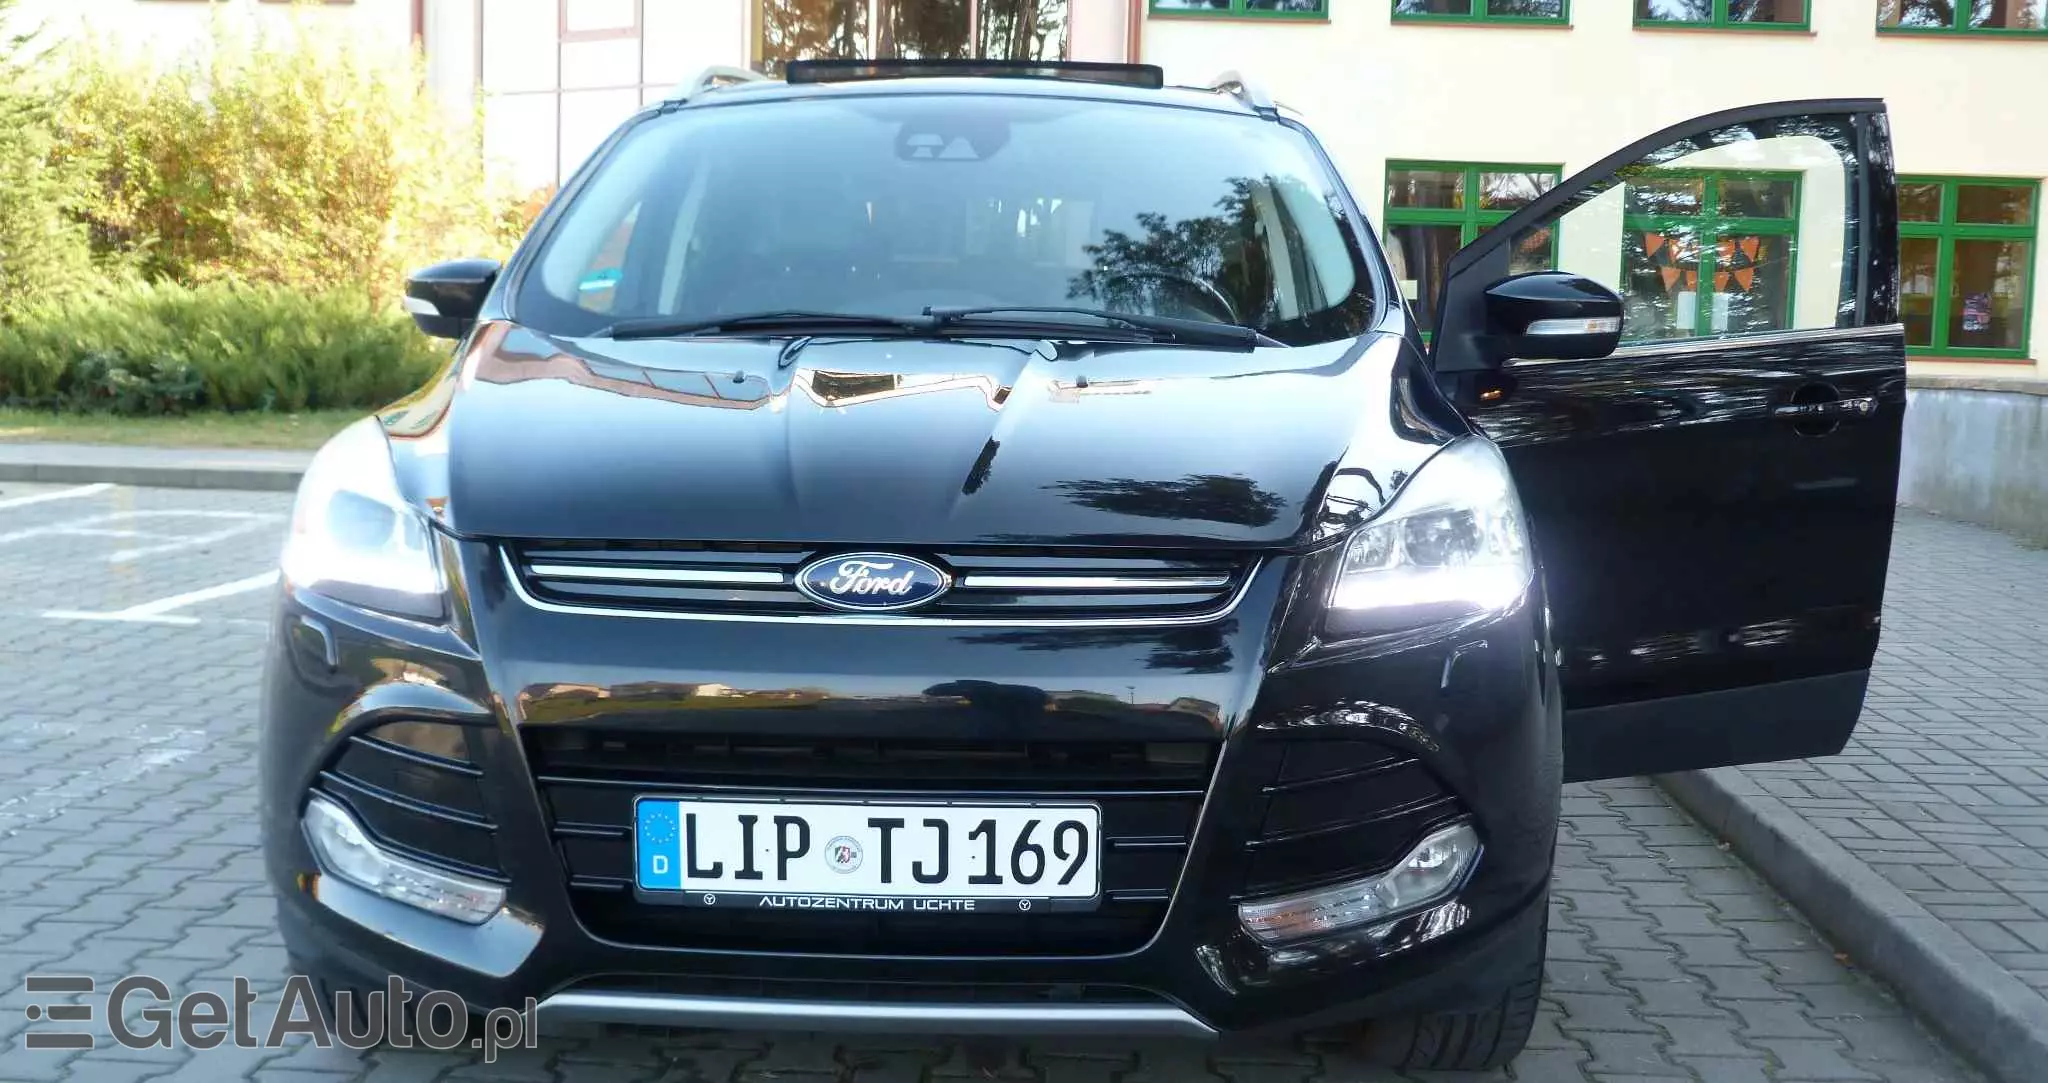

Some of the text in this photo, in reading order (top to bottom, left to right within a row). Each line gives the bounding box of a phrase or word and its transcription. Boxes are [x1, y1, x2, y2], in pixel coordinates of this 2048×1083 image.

[829, 560, 915, 596] Ford
[685, 812, 811, 881] LIP
[867, 817, 950, 885] TJ
[967, 818, 1089, 886] 169
[652, 855, 668, 875] D
[759, 895, 904, 910] AUTOZENTRUM
